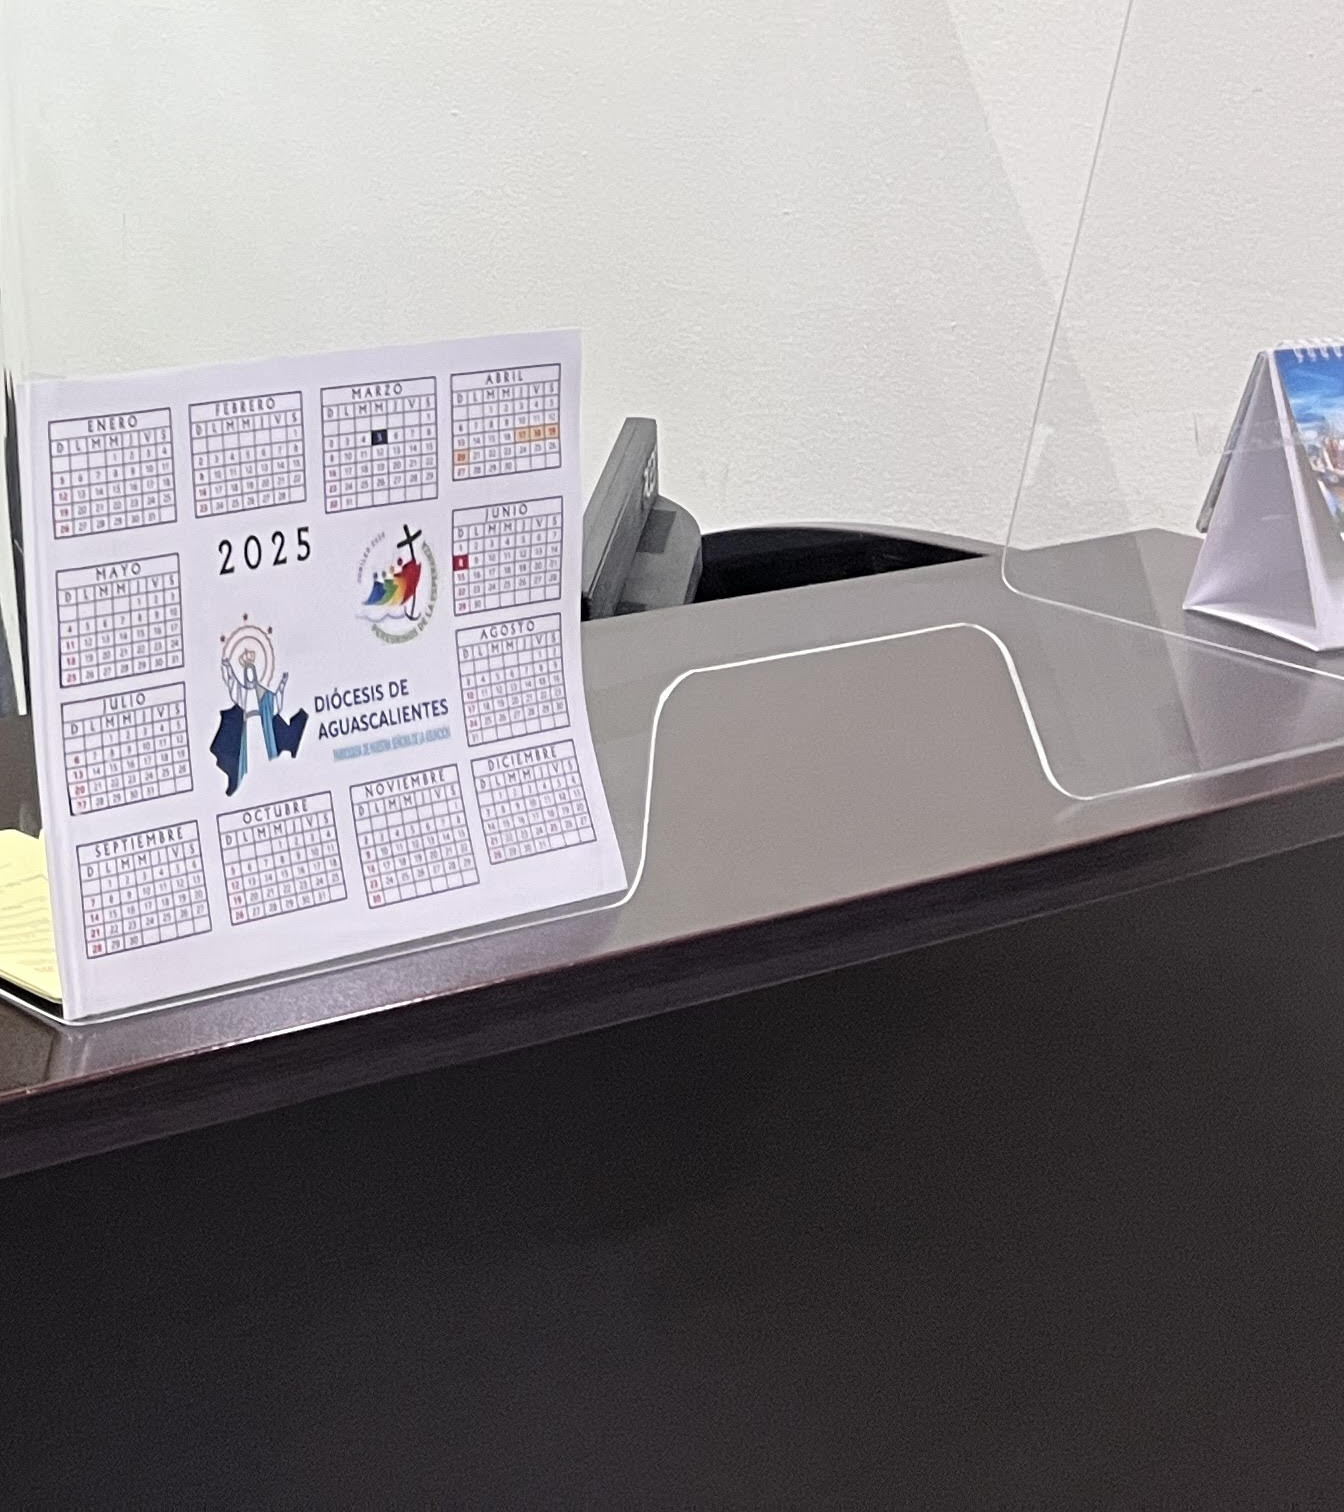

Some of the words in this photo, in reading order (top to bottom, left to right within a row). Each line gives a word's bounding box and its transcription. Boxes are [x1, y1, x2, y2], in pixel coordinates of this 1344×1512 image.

[485, 370, 524, 385] ABRIL
[352, 383, 403, 400] MARZO
[215, 397, 275, 416] FEBRERO
[88, 415, 138, 433] ENERO
[485, 503, 528, 522] JUNIO
[218, 526, 311, 575] 2025
[96, 562, 141, 581] MAYO
[480, 620, 535, 640] AGOSTO
[103, 692, 146, 714] JULIO
[314, 684, 384, 713] DIÓCESIS
[389, 678, 409, 698] DE
[318, 698, 449, 740] AGUASCALIENTES
[487, 746, 557, 771] DICIEMBRE
[365, 768, 445, 798] NOVIEMBRE
[242, 798, 308, 824] OCTUBRE
[95, 827, 183, 858] SEPTIEMBRE
